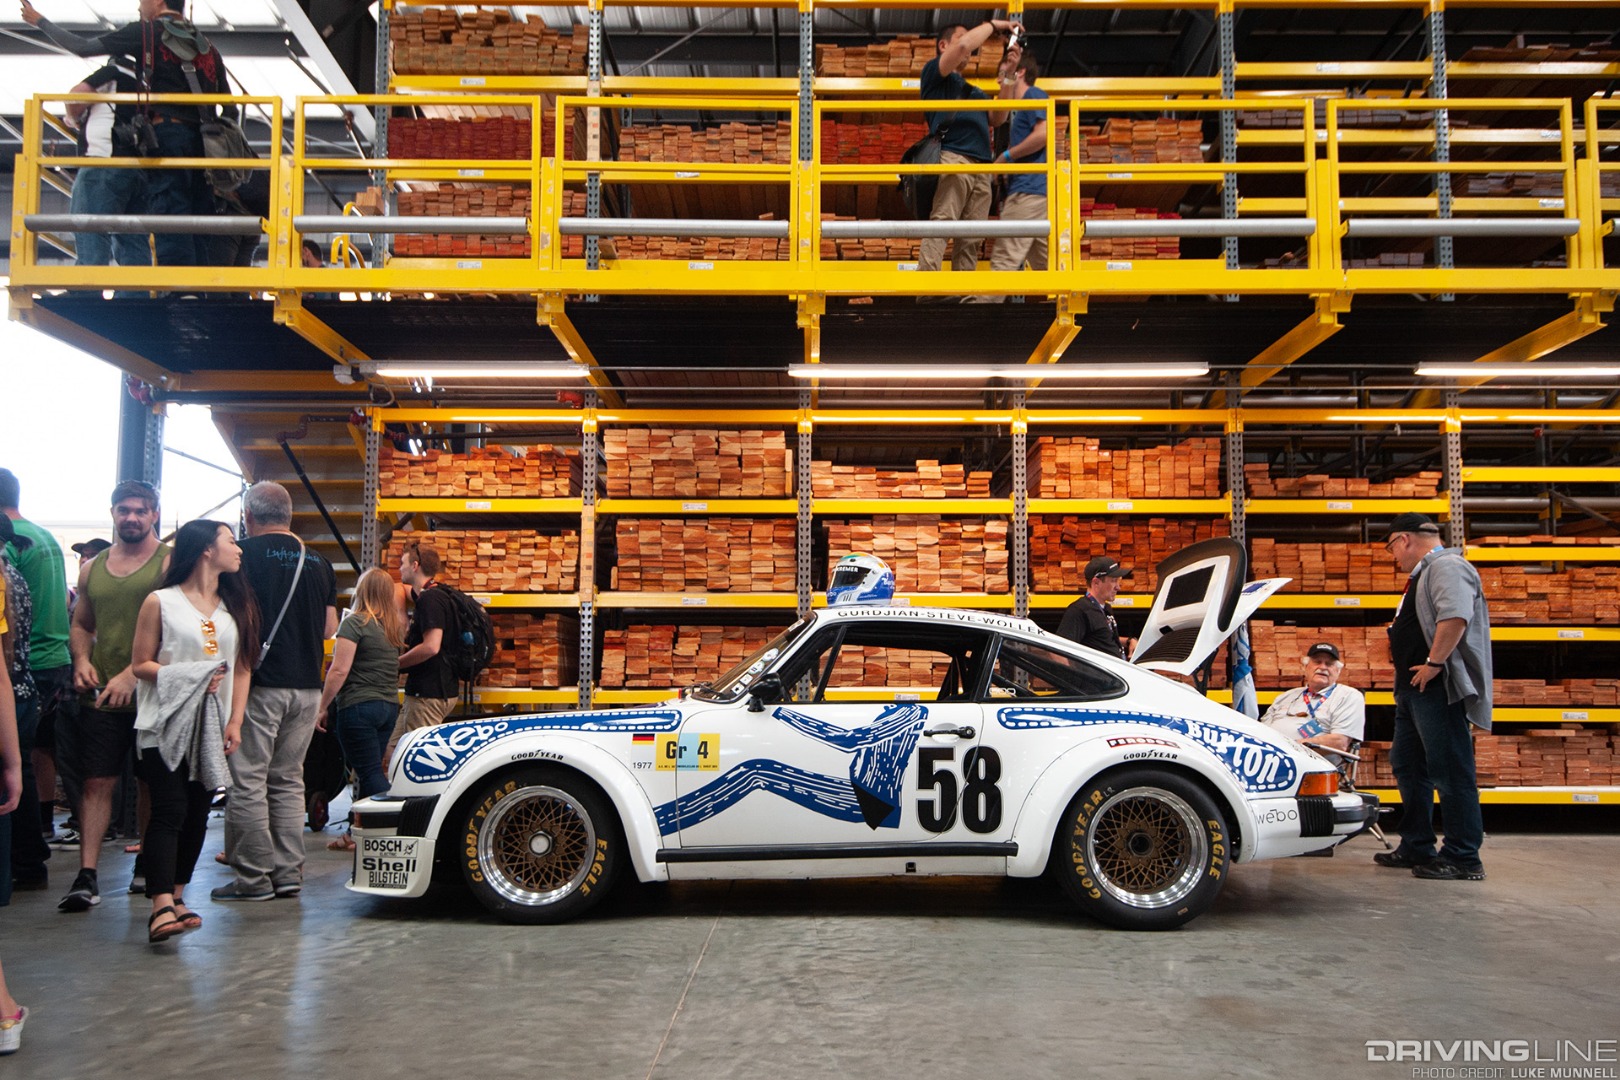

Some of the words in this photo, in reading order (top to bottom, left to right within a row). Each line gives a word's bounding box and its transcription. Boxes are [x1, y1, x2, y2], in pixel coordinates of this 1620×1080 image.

[838, 609, 1046, 636] GURDJIAN-STEVE-WOLLEK
[665, 740, 688, 760] Gr
[697, 740, 709, 759] 4
[1187, 718, 1281, 784] Burton
[633, 761, 652, 769] 1977
[916, 745, 1004, 834] 58
[364, 840, 402, 852] BOSCH
[1207, 819, 1225, 880] EAGLE
[363, 857, 417, 872] Shell
[579, 838, 608, 896] EAGLE
[369, 871, 408, 884] BILSTEIN
